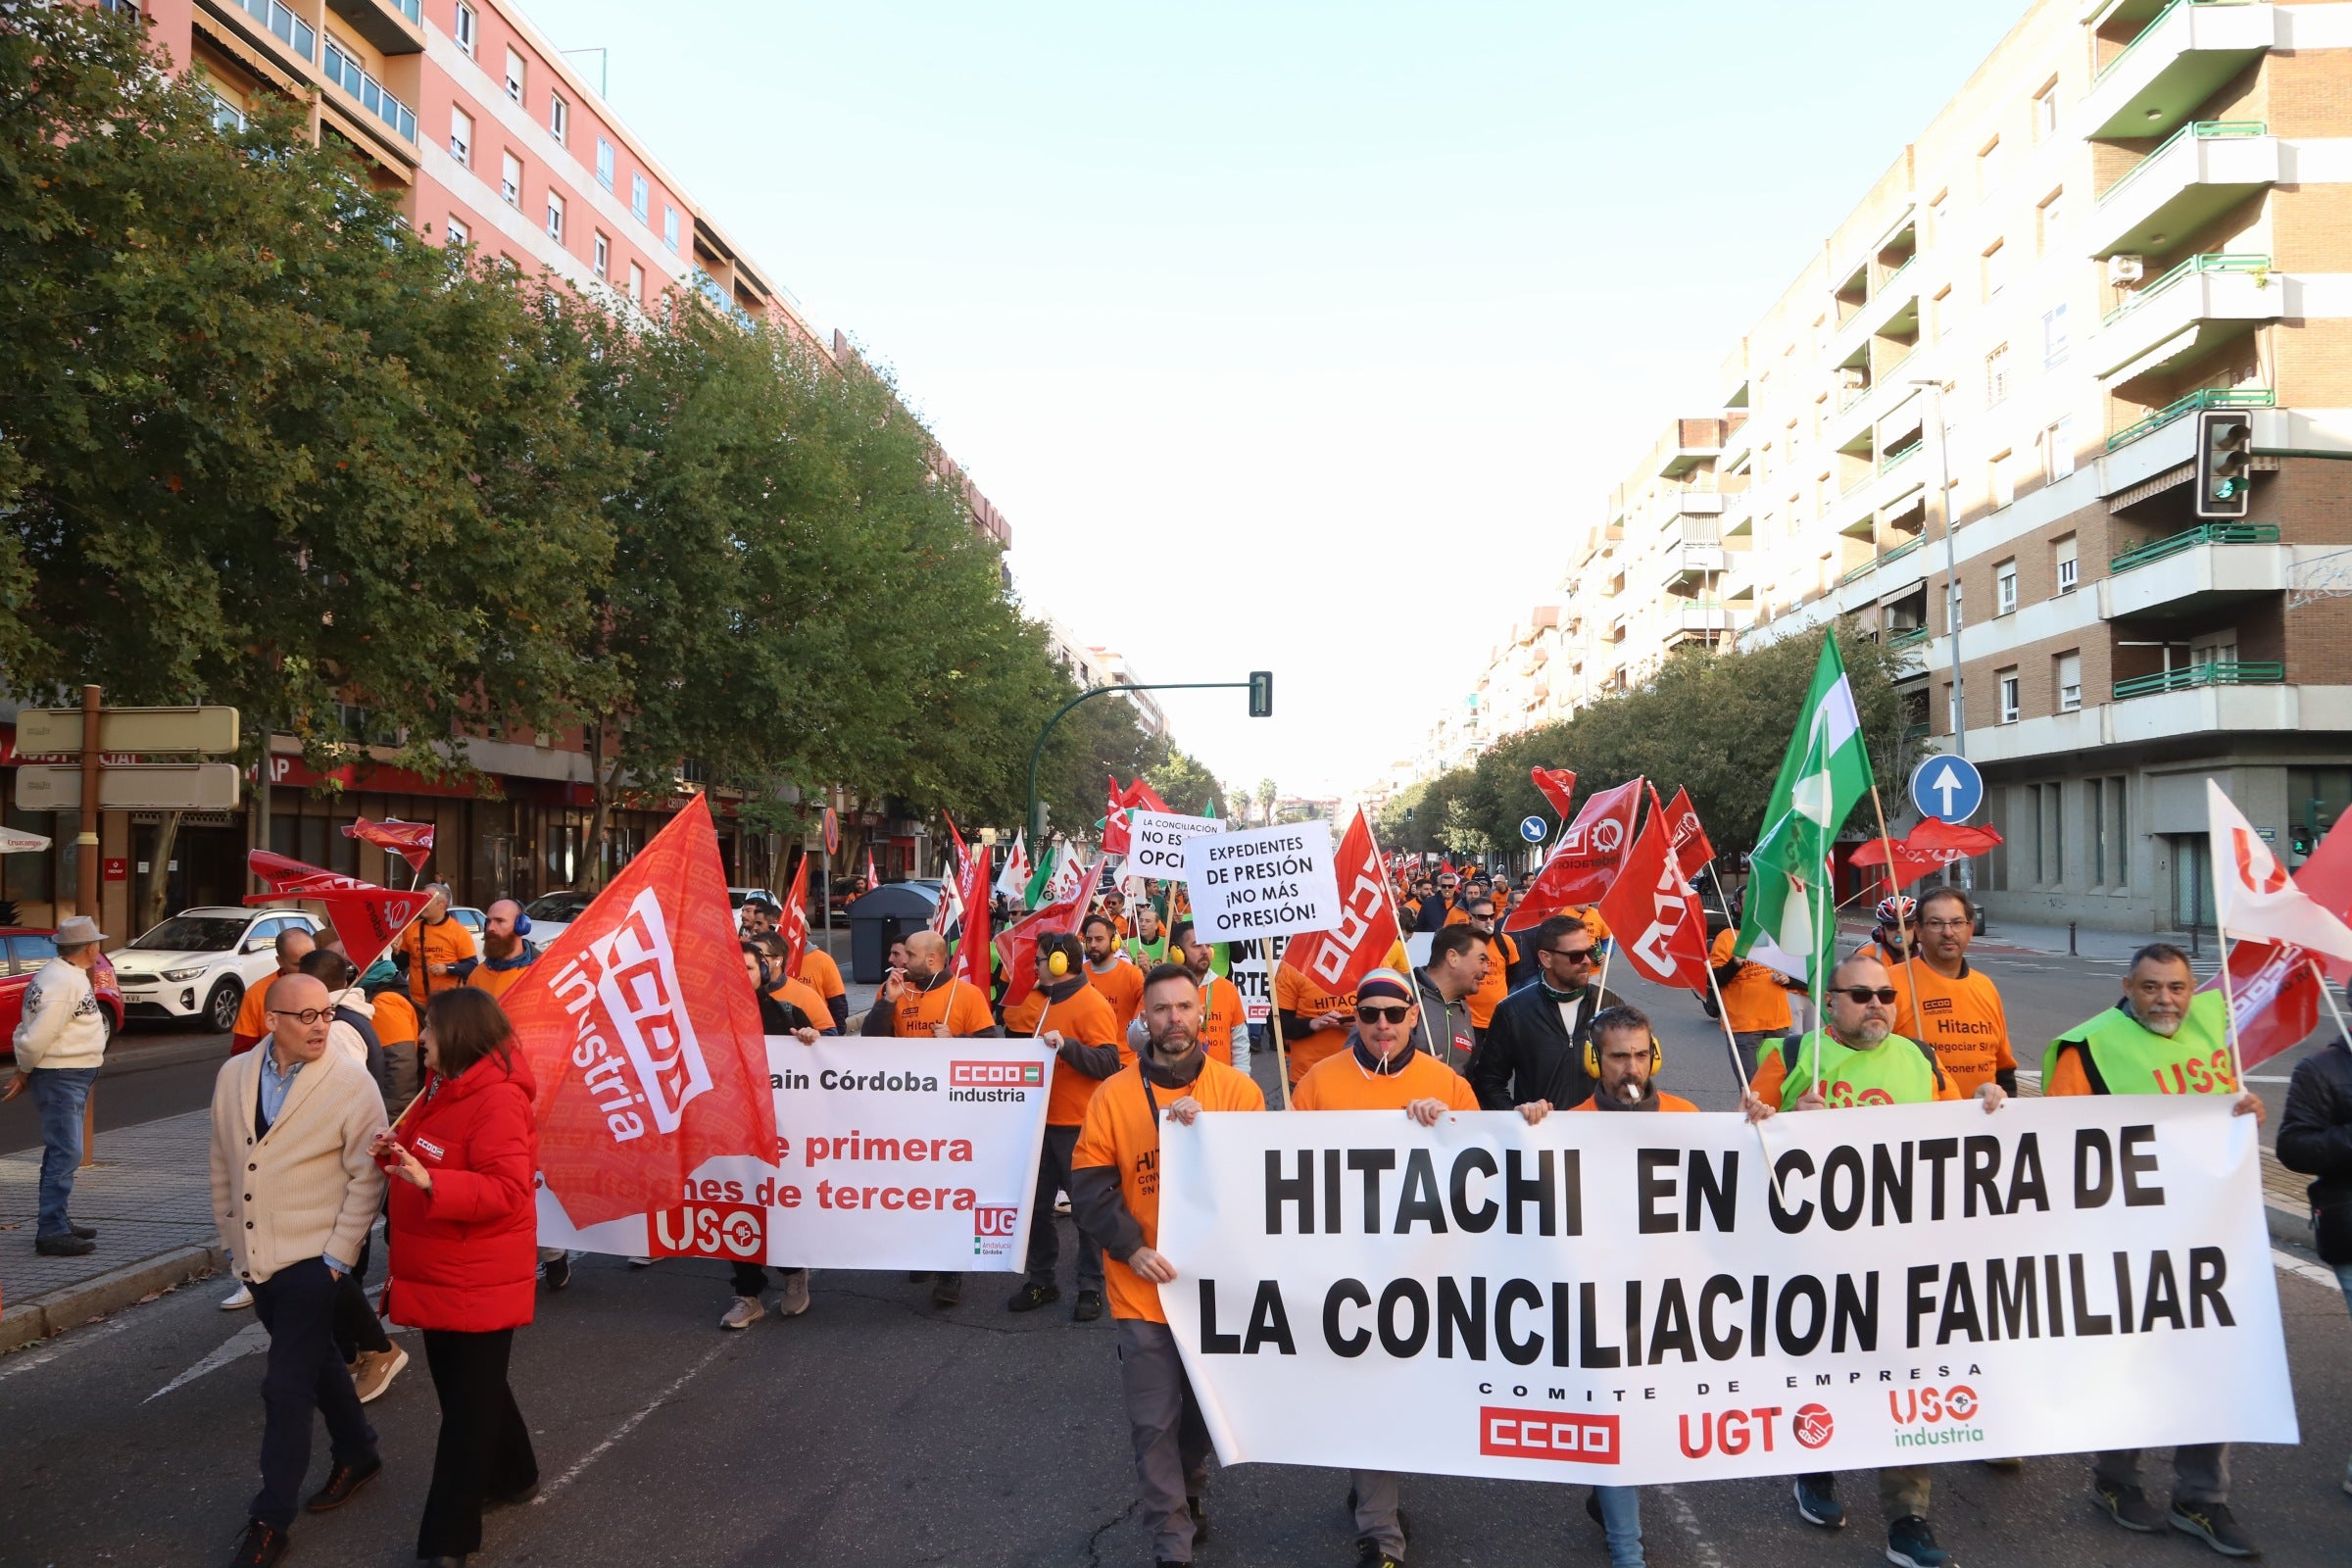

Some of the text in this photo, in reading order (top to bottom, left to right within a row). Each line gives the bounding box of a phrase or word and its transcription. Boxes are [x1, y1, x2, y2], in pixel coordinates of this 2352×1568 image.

[1142, 830, 1182, 846] NO ES
[1154, 819, 1218, 834] CONCILIACIÓN
[1139, 850, 1184, 869] OPCI
[1209, 837, 1304, 861] EXPEDIENTES
[1206, 855, 1313, 885] DE PRESIÓN
[1226, 881, 1298, 907] ¡NO MÁS
[1216, 904, 1317, 930] OPRESIÓN!
[1314, 995, 1358, 1009] HITAC
[1924, 1000, 1950, 1009] CCOO
[1937, 1019, 1992, 1035] Hitachi
[819, 1069, 938, 1092] Córdoba
[955, 1065, 1020, 1082] CCOO
[949, 1088, 1025, 1102] industria
[805, 1129, 973, 1168] primera
[1264, 1124, 2166, 1237] HITACHI EN CONTRA DE
[755, 1177, 802, 1208] de
[815, 1178, 977, 1211] tercera
[656, 1206, 761, 1257] USO
[979, 1209, 1017, 1235] UG
[1199, 1246, 2237, 1369] LA CONCILIACION FAMILIAR
[1478, 1363, 1982, 1402] COMITE DE EMPRESA
[1888, 1384, 1979, 1425] USO
[1490, 1418, 1610, 1453] CCOO
[1678, 1406, 1783, 1459] UGT
[1893, 1424, 1984, 1447] industria
